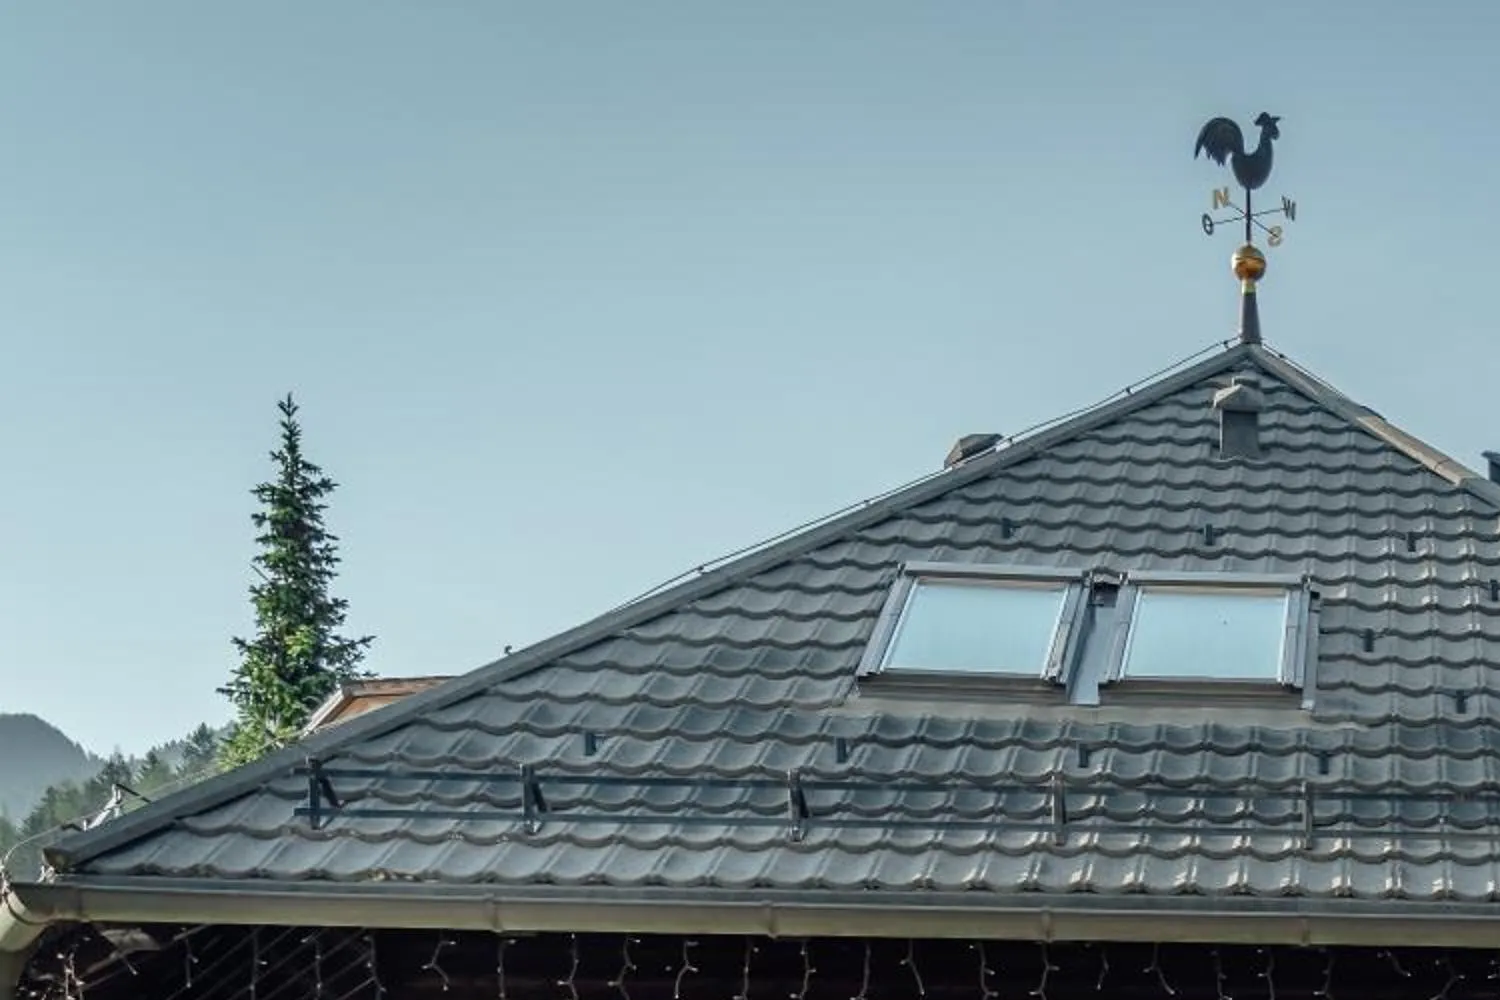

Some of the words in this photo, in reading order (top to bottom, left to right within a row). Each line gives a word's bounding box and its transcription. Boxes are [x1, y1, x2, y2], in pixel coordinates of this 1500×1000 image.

[1212, 186, 1229, 210] N
[1281, 195, 1296, 221] W
[1267, 225, 1283, 247] S
